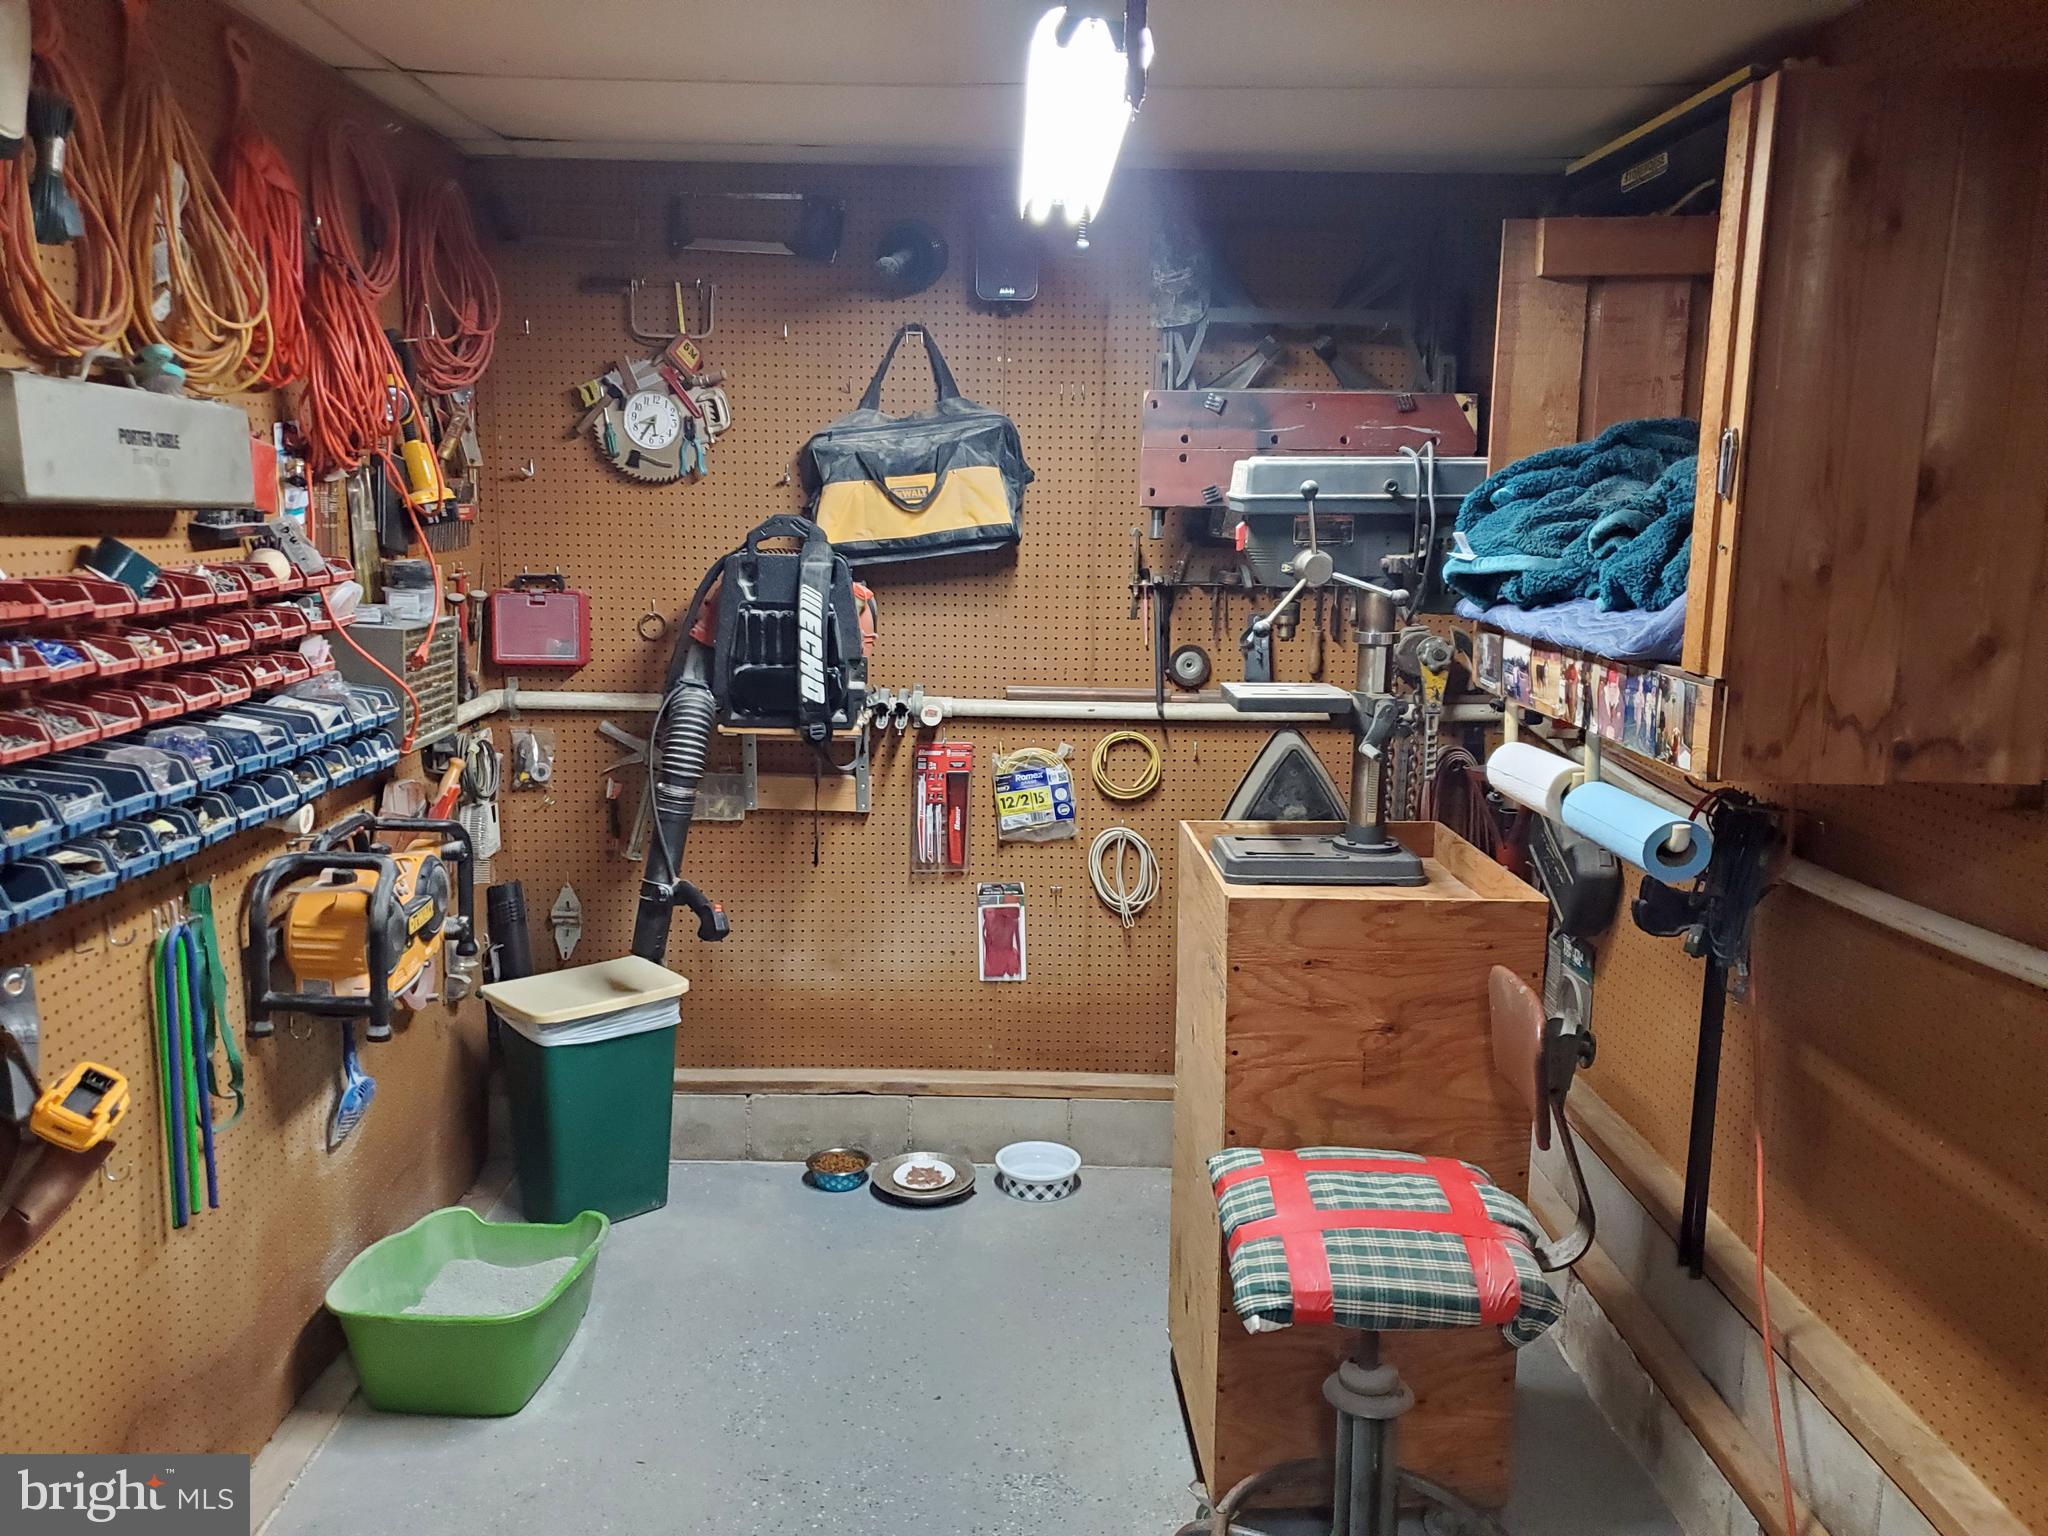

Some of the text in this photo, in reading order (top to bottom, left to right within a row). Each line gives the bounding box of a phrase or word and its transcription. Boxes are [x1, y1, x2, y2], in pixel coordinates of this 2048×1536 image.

[643, 396, 650, 405] 11
[652, 395, 661, 404] 12
[634, 402, 642, 411] 10
[631, 411, 637, 420] 9
[670, 408, 676, 417] 2
[633, 422, 639, 431] 8
[672, 419, 677, 428] 3
[667, 429, 672, 437] 4
[648, 436, 654, 444] 6
[659, 435, 665, 444] 5
[800, 608, 825, 704] ECHO
[1015, 771, 1044, 783] Romex
[999, 791, 1045, 810] 12/2 15
